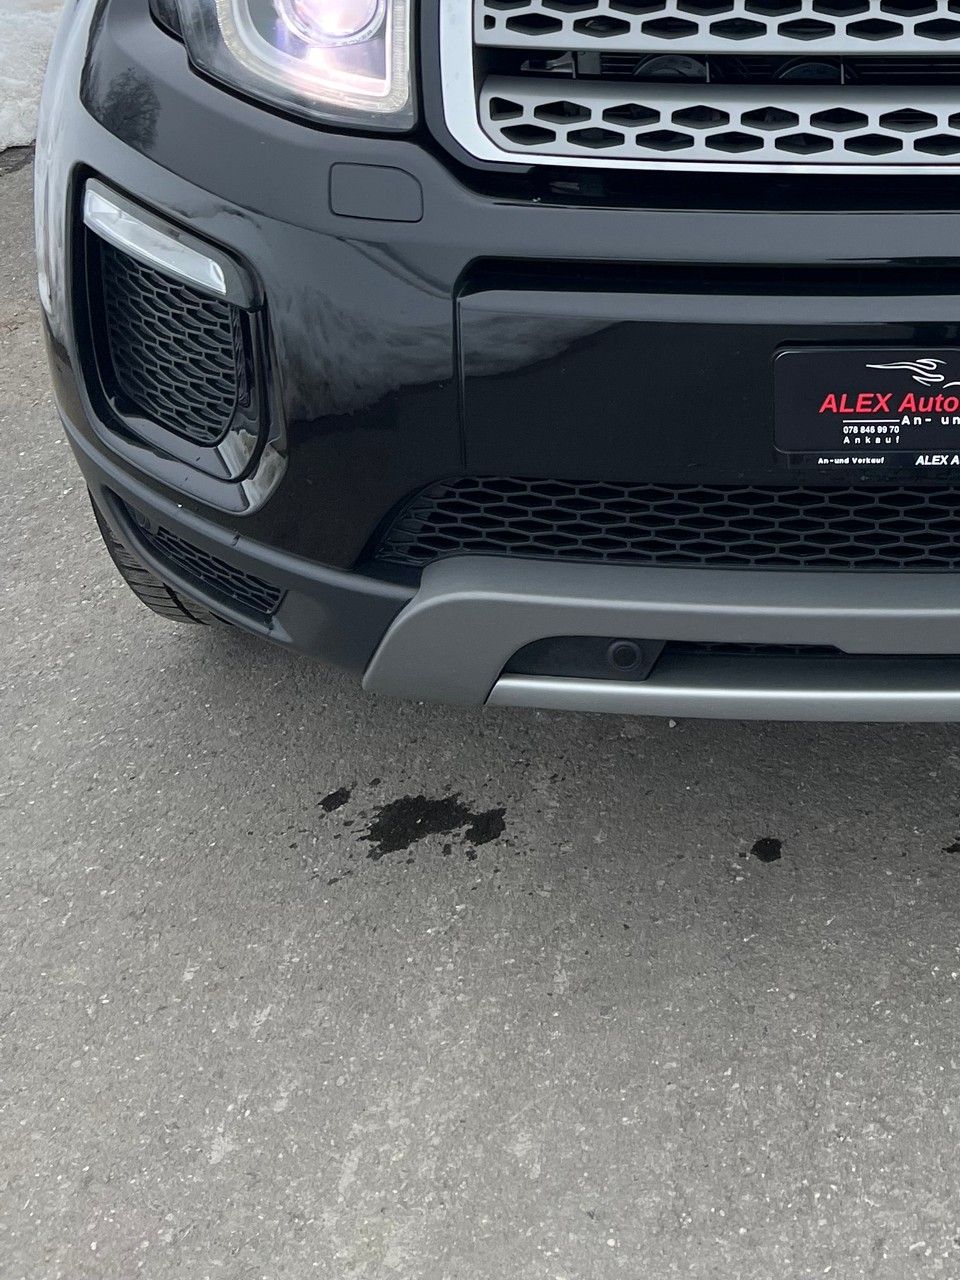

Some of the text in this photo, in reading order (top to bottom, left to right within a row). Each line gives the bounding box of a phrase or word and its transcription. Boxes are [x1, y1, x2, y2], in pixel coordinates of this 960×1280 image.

[819, 393, 893, 413] ALEX
[901, 414, 932, 426] An-
[889, 425, 900, 434] 70
[843, 435, 900, 444] Ankauf
[852, 456, 885, 465] Verkauf
[915, 455, 949, 466] ALEX
